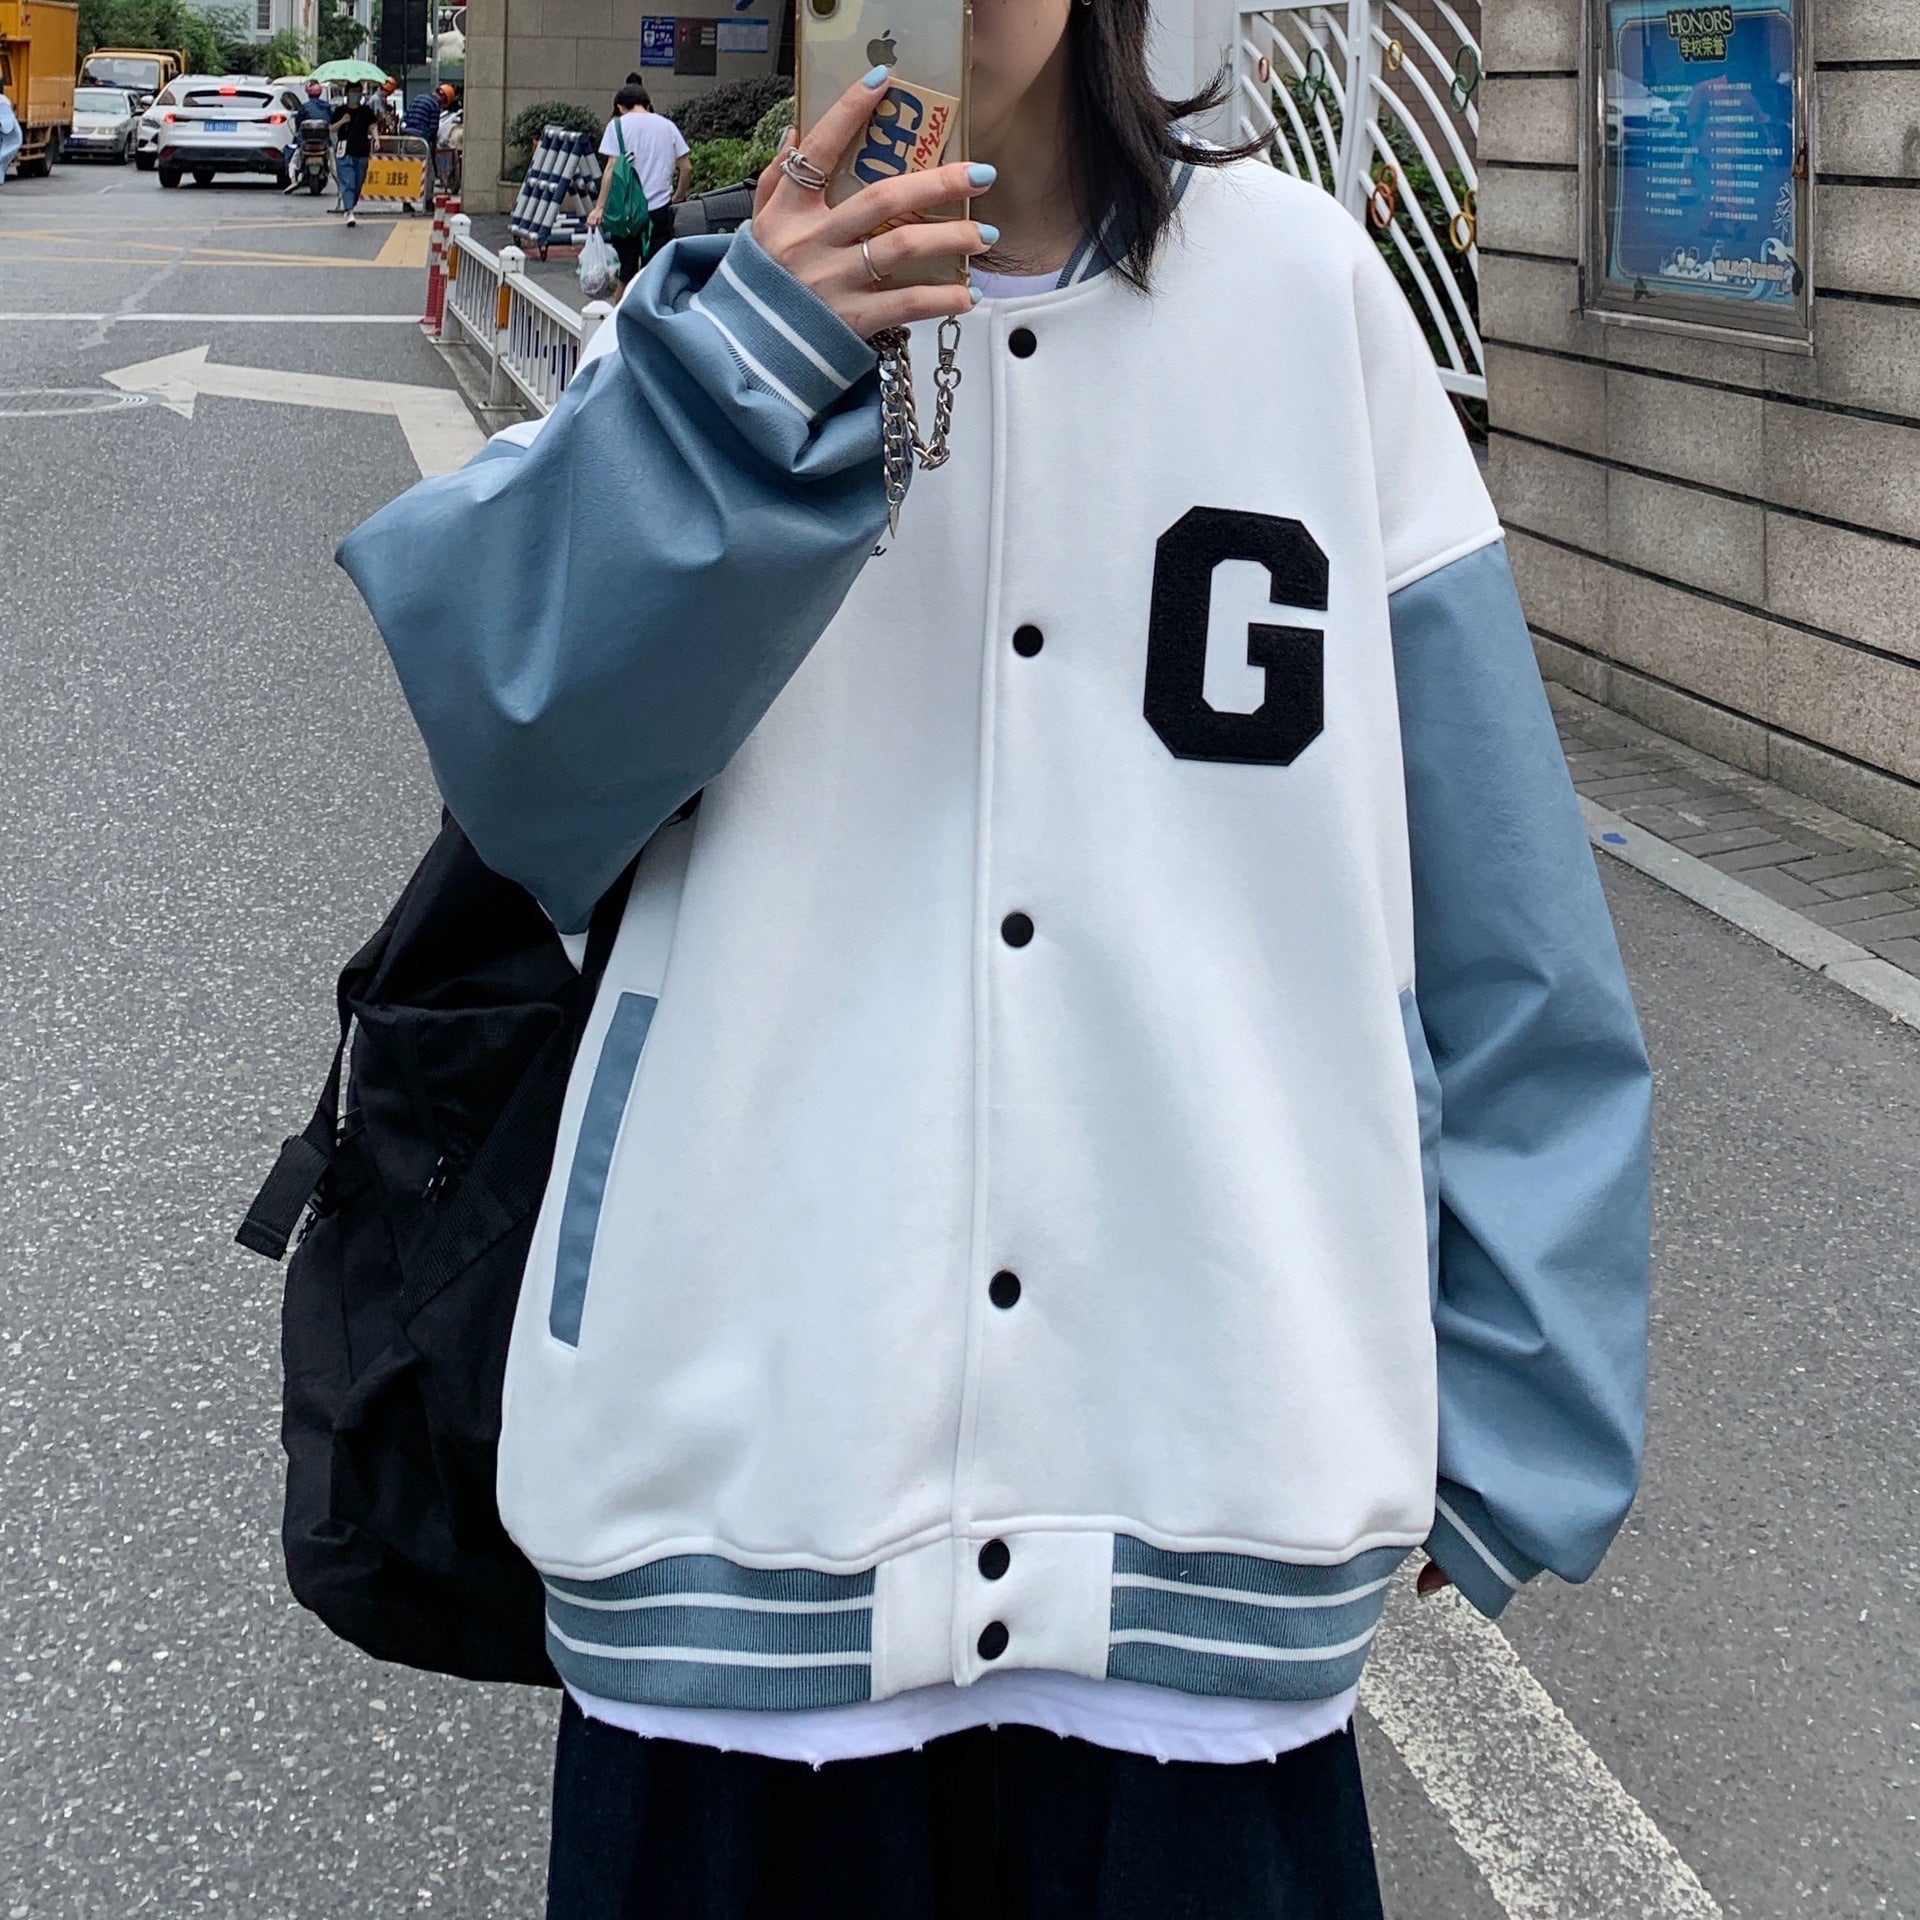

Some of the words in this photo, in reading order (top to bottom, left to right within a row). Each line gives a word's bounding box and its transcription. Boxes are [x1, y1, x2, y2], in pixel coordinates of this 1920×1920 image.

[1669, 10, 1732, 34] HONORS
[1680, 35, 1725, 57] 学校荣誉
[386, 171, 409, 187] 注意安全
[1143, 505, 1329, 767] G
